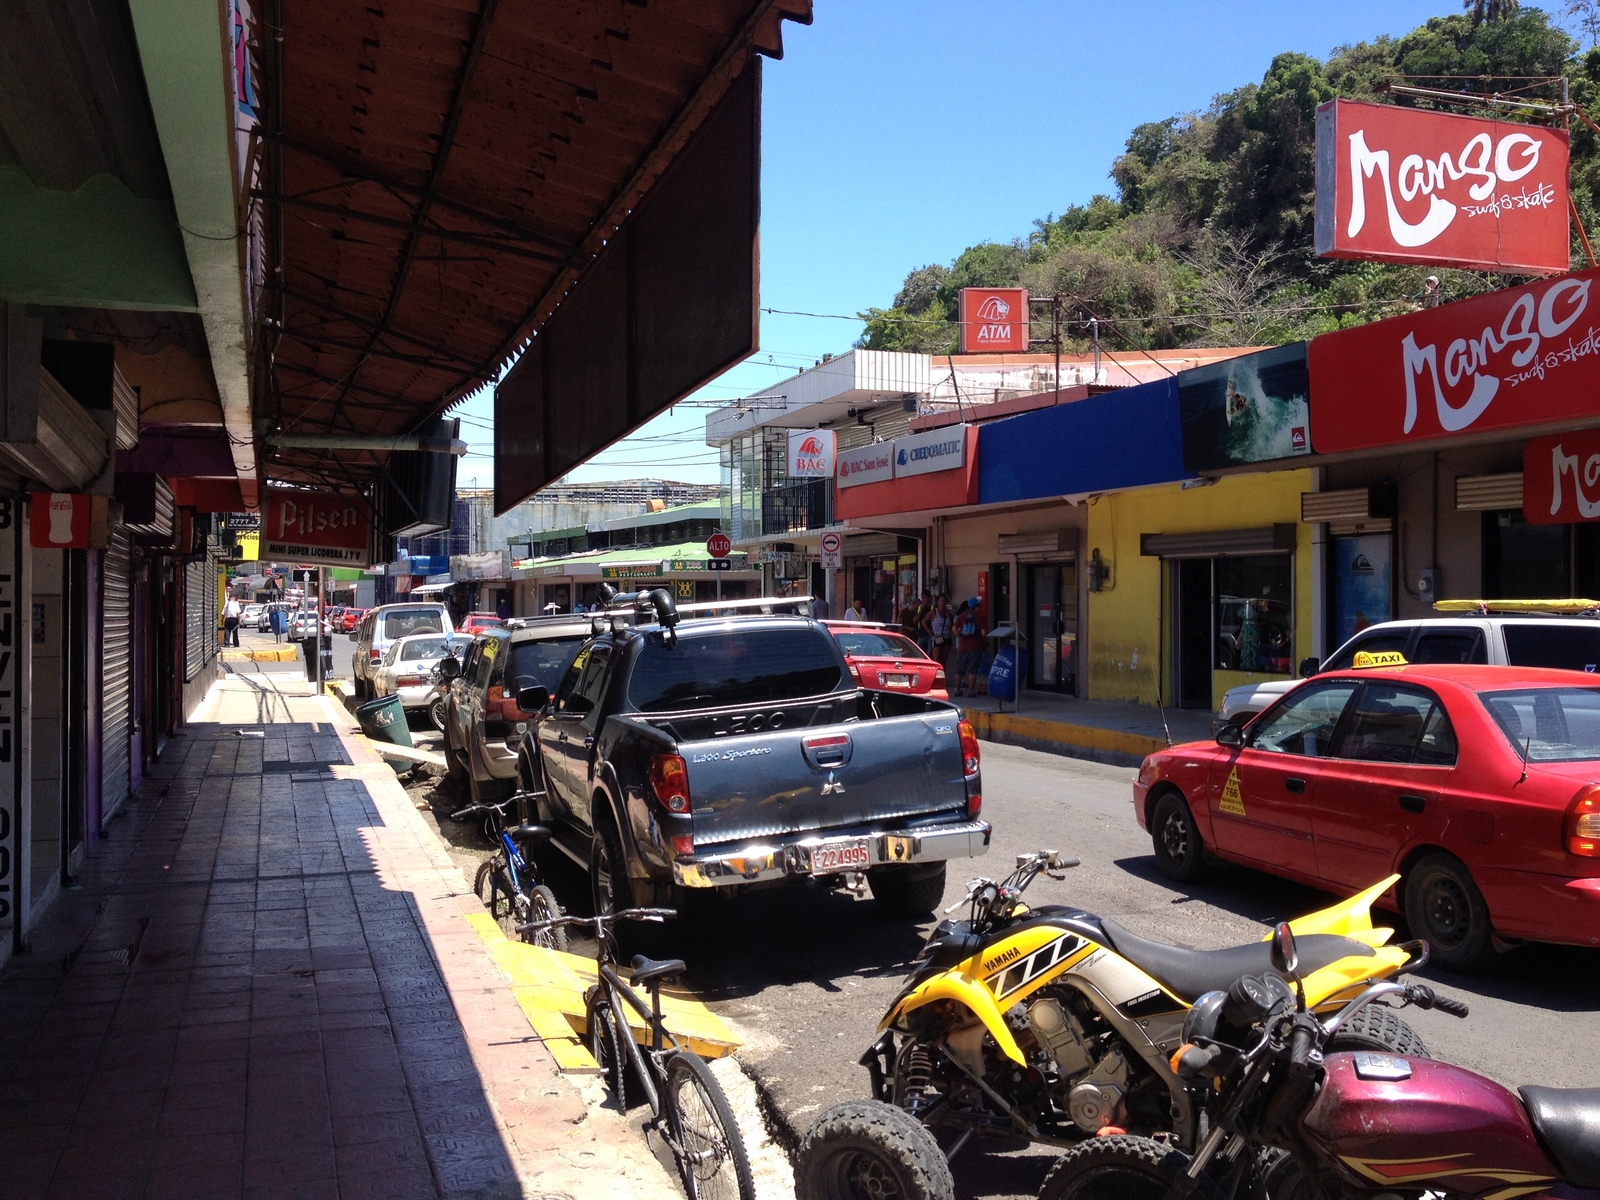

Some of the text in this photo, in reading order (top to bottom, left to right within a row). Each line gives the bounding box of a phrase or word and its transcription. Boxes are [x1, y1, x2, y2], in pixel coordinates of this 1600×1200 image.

[1347, 129, 1542, 247] Mango
[1517, 183, 1554, 208] skate
[977, 325, 1010, 339] ATM
[1402, 278, 1592, 434] Mango
[910, 440, 961, 462] CREDOMATIC
[796, 458, 826, 471] BAC
[278, 499, 358, 540] Pilsen
[269, 543, 286, 555] MINI
[287, 545, 310, 557] SUPER
[311, 548, 343, 559] LICORERA
[709, 541, 729, 550] ALTO
[1373, 654, 1400, 664] TAXI
[1225, 786, 1238, 798] 766
[1228, 778, 1237, 787] TP
[821, 845, 868, 867] 224995
[984, 946, 1021, 972] YAMAHA
